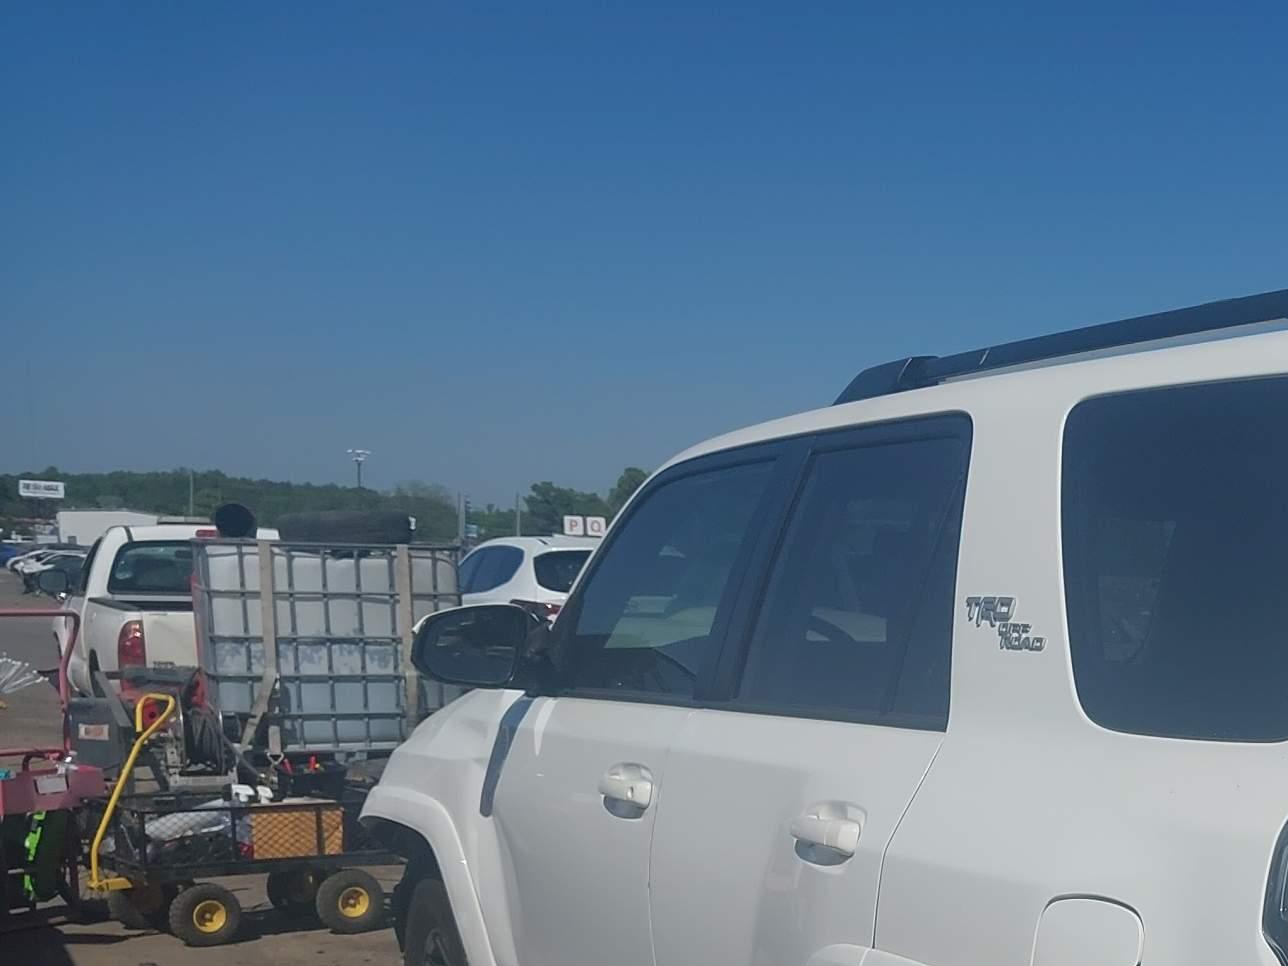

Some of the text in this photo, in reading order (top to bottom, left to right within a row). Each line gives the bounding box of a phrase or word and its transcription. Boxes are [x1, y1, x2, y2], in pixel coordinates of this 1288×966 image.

[569, 519, 578, 532] P
[966, 596, 1016, 628] TRD
[999, 635, 1046, 651] ROAD
